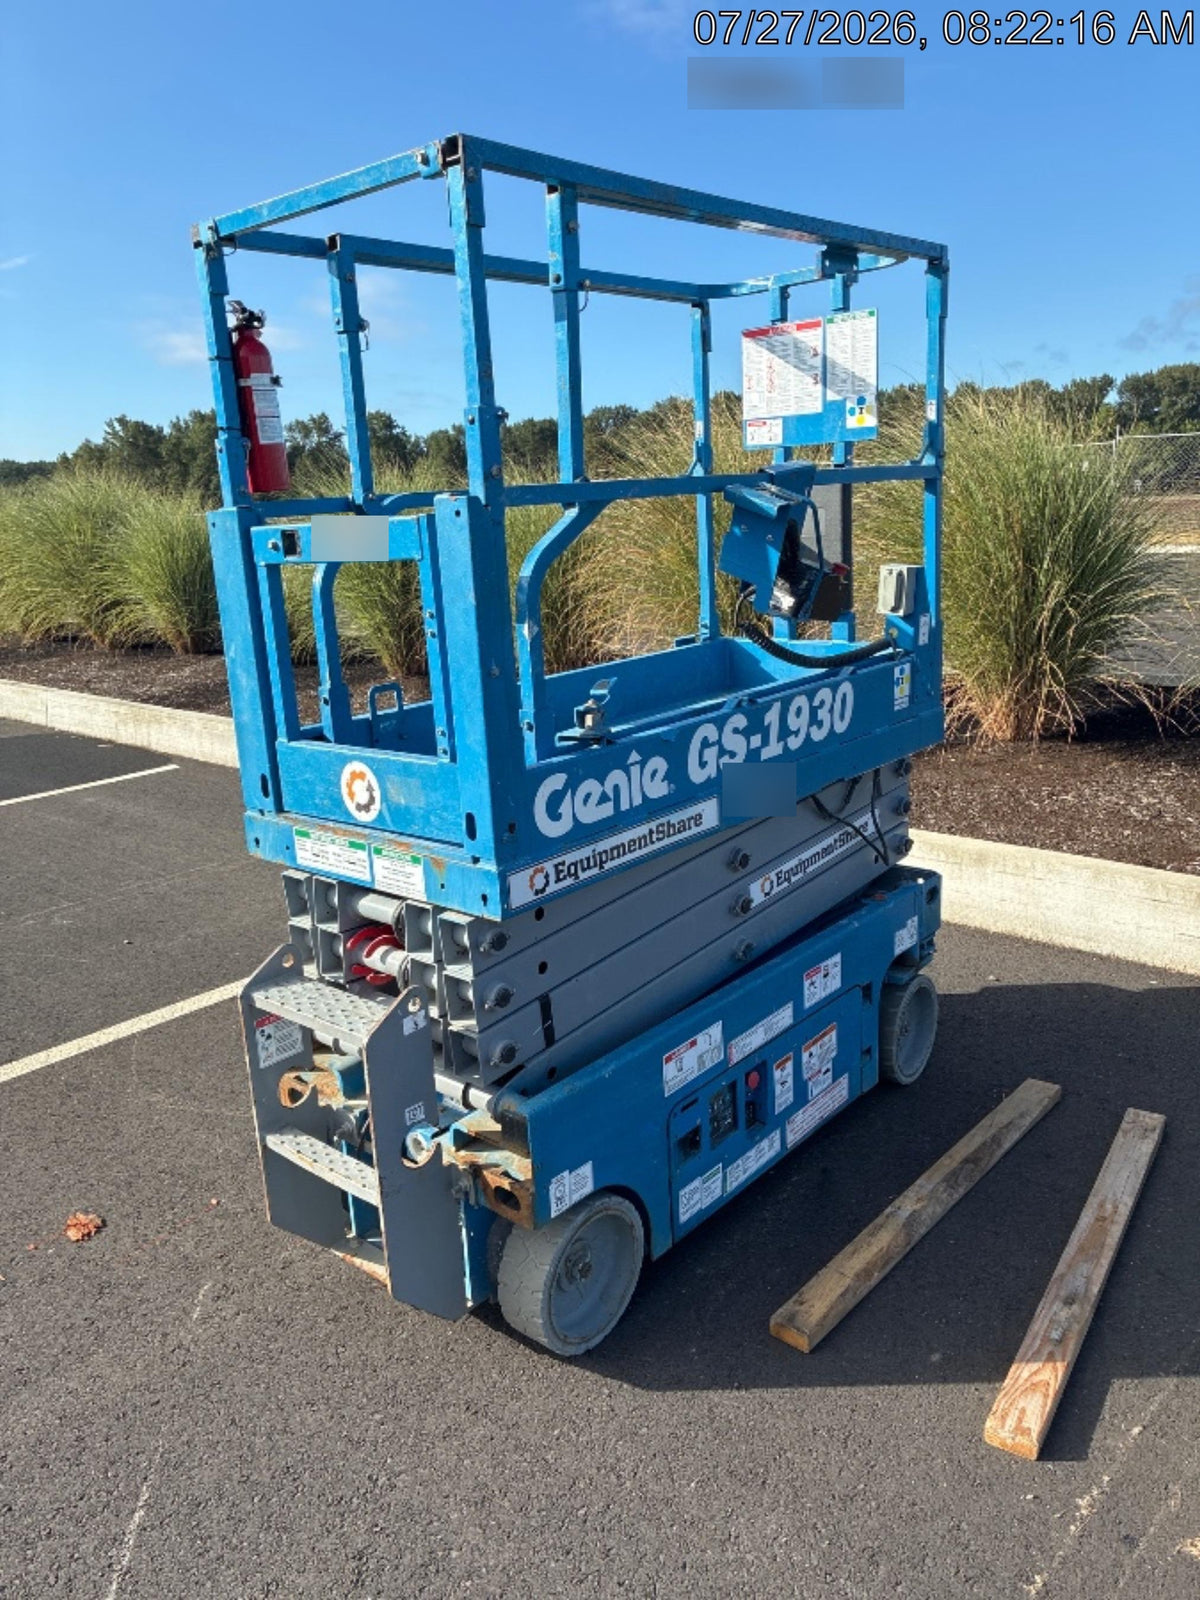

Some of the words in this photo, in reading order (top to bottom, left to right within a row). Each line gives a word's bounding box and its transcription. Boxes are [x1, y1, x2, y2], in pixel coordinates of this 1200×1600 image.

[534, 749, 670, 838] Genie
[687, 680, 855, 785] GS-1930
[553, 810, 704, 884] EquipmentShare
